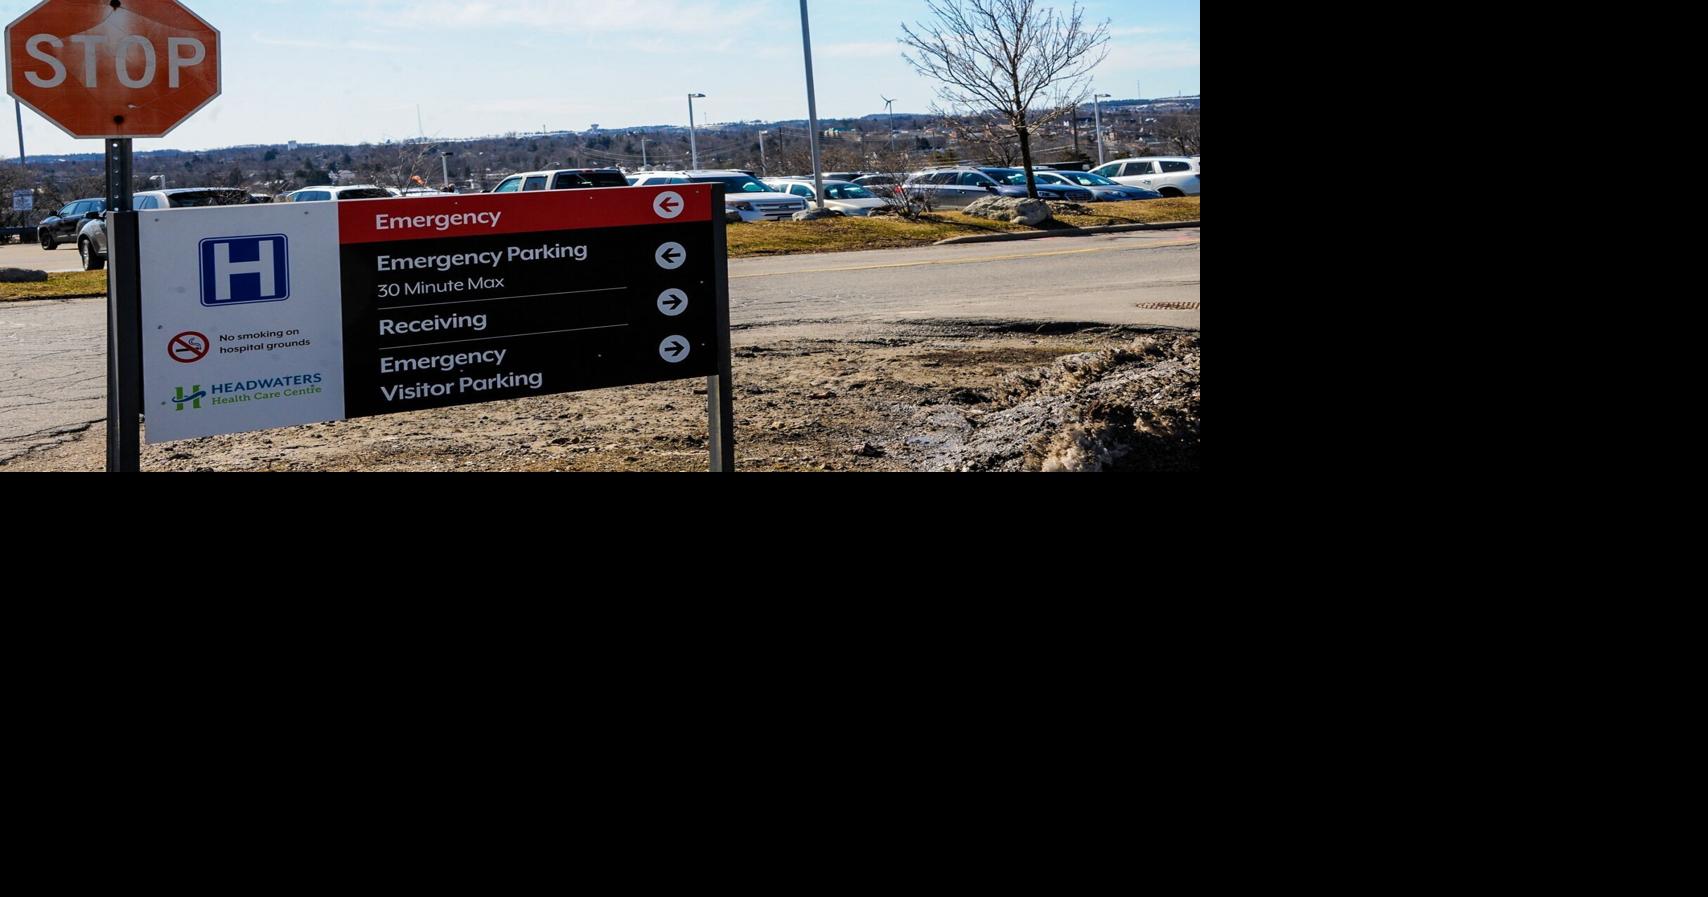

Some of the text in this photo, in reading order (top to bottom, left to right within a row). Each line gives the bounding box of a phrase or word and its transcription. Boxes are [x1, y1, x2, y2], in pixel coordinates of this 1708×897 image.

[24, 33, 206, 88] STOP
[375, 211, 501, 231] Emergency
[377, 243, 588, 272] Emergency Parking
[213, 239, 276, 301] H
[377, 276, 505, 298] 30 Minute Max
[237, 329, 283, 340] smoking
[379, 313, 487, 335] Receiving
[219, 338, 311, 354] hospital grounds
[380, 349, 507, 373] Emergency
[211, 373, 322, 394] HEADWATERS
[381, 372, 543, 401] Visitor Parking
[211, 385, 322, 405] Health Care Centre
